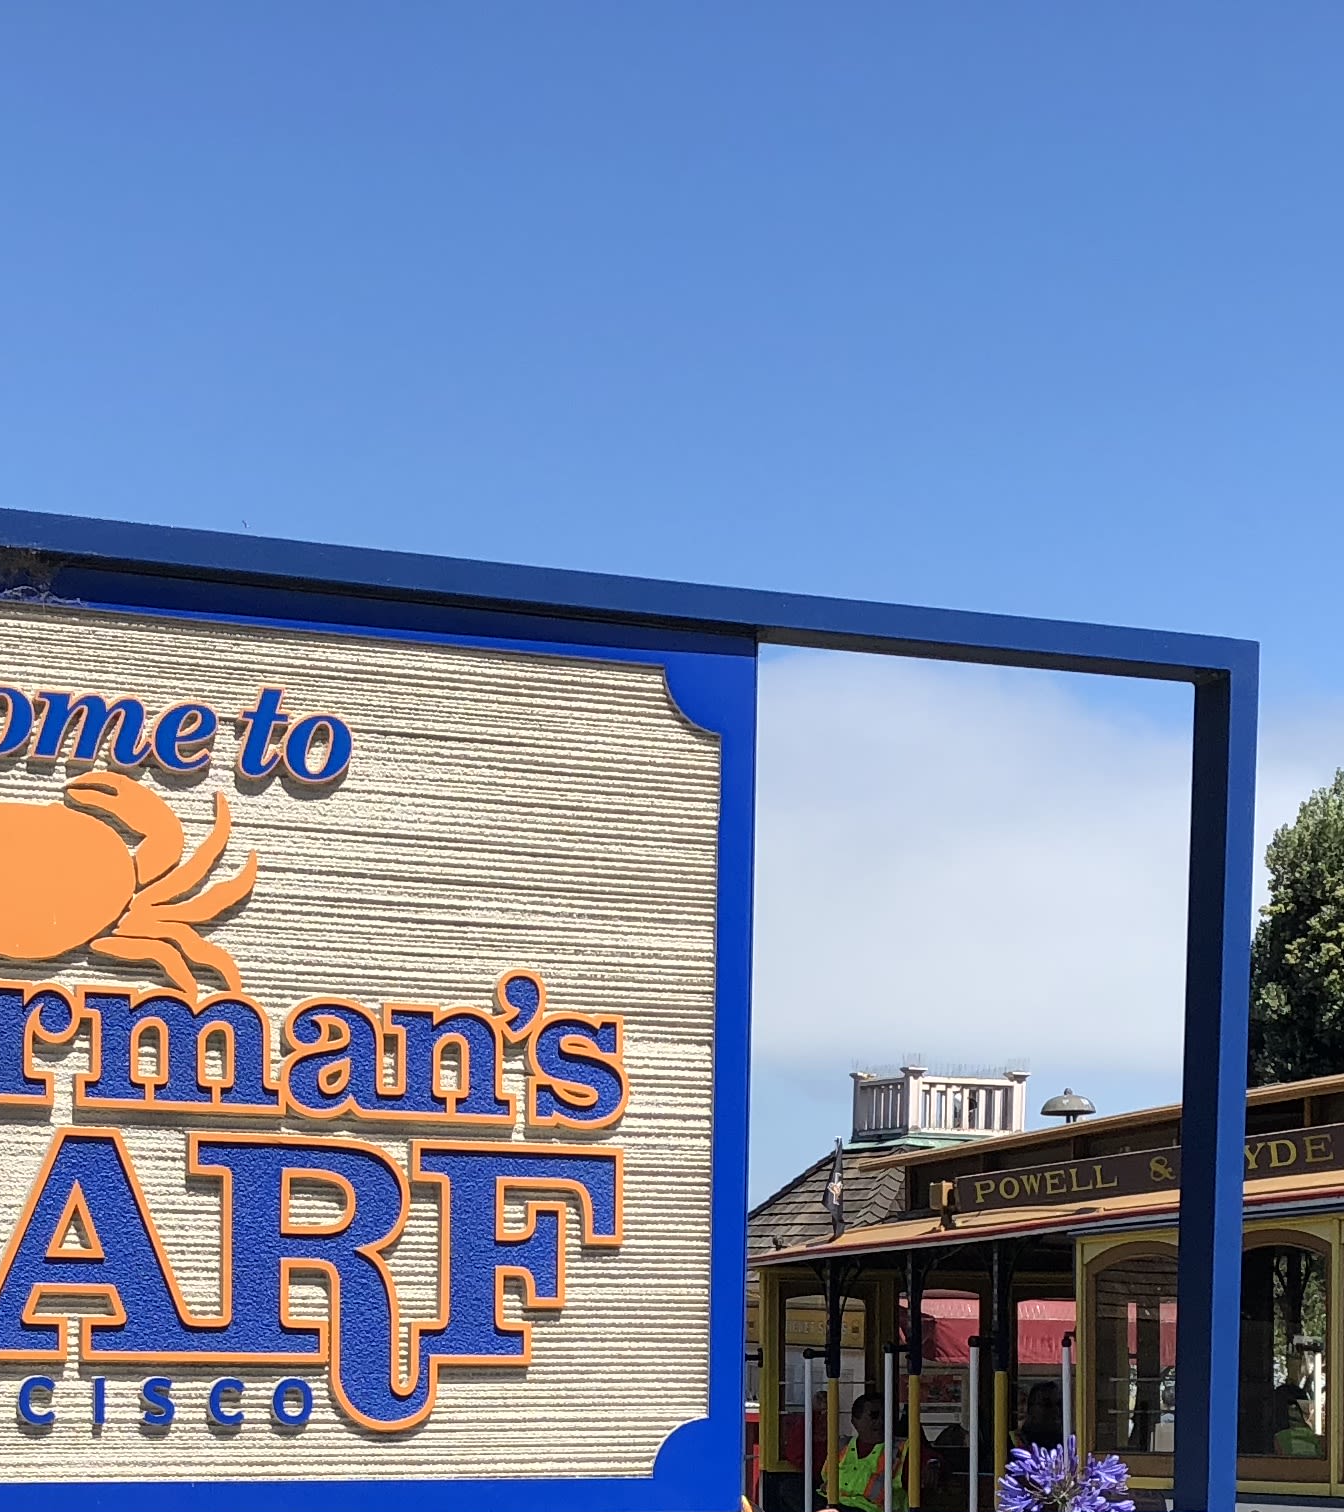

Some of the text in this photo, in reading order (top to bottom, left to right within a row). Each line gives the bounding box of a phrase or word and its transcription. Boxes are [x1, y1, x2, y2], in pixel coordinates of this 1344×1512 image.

[237, 686, 354, 788] to
[974, 1164, 1118, 1204] POWELL
[1149, 1155, 1176, 1182] &
[1244, 1132, 1335, 1170] YDE
